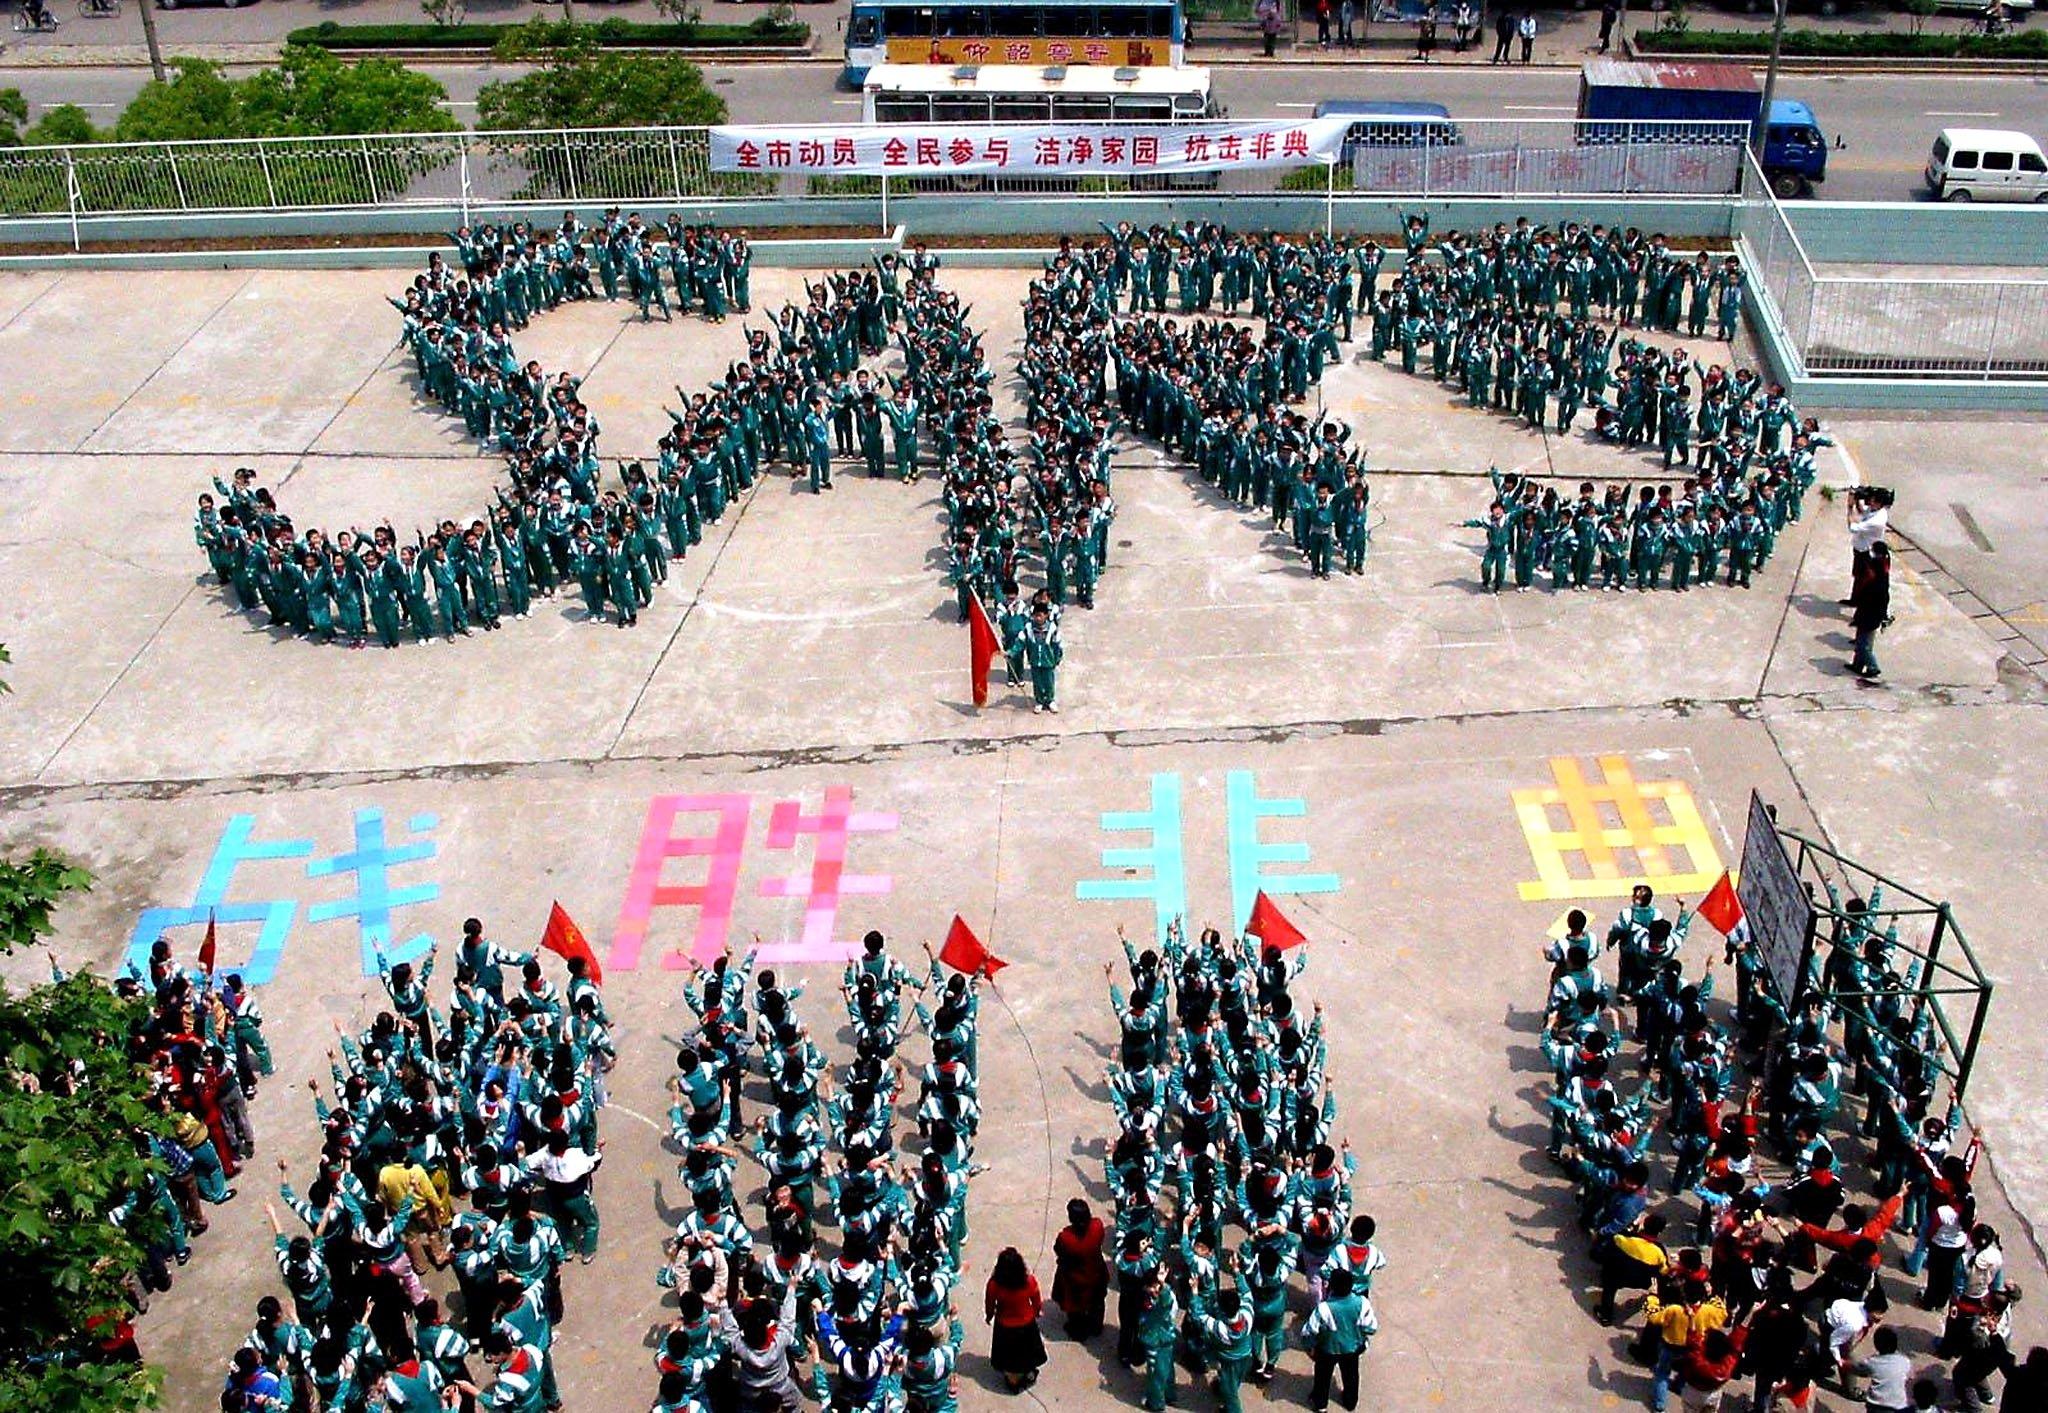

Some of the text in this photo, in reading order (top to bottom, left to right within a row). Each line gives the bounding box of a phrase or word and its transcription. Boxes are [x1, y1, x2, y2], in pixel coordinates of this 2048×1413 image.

[736, 130, 1309, 168] 全市动员 全民参与 洁净家园 抗击非典
[196, 206, 1832, 648] SARS
